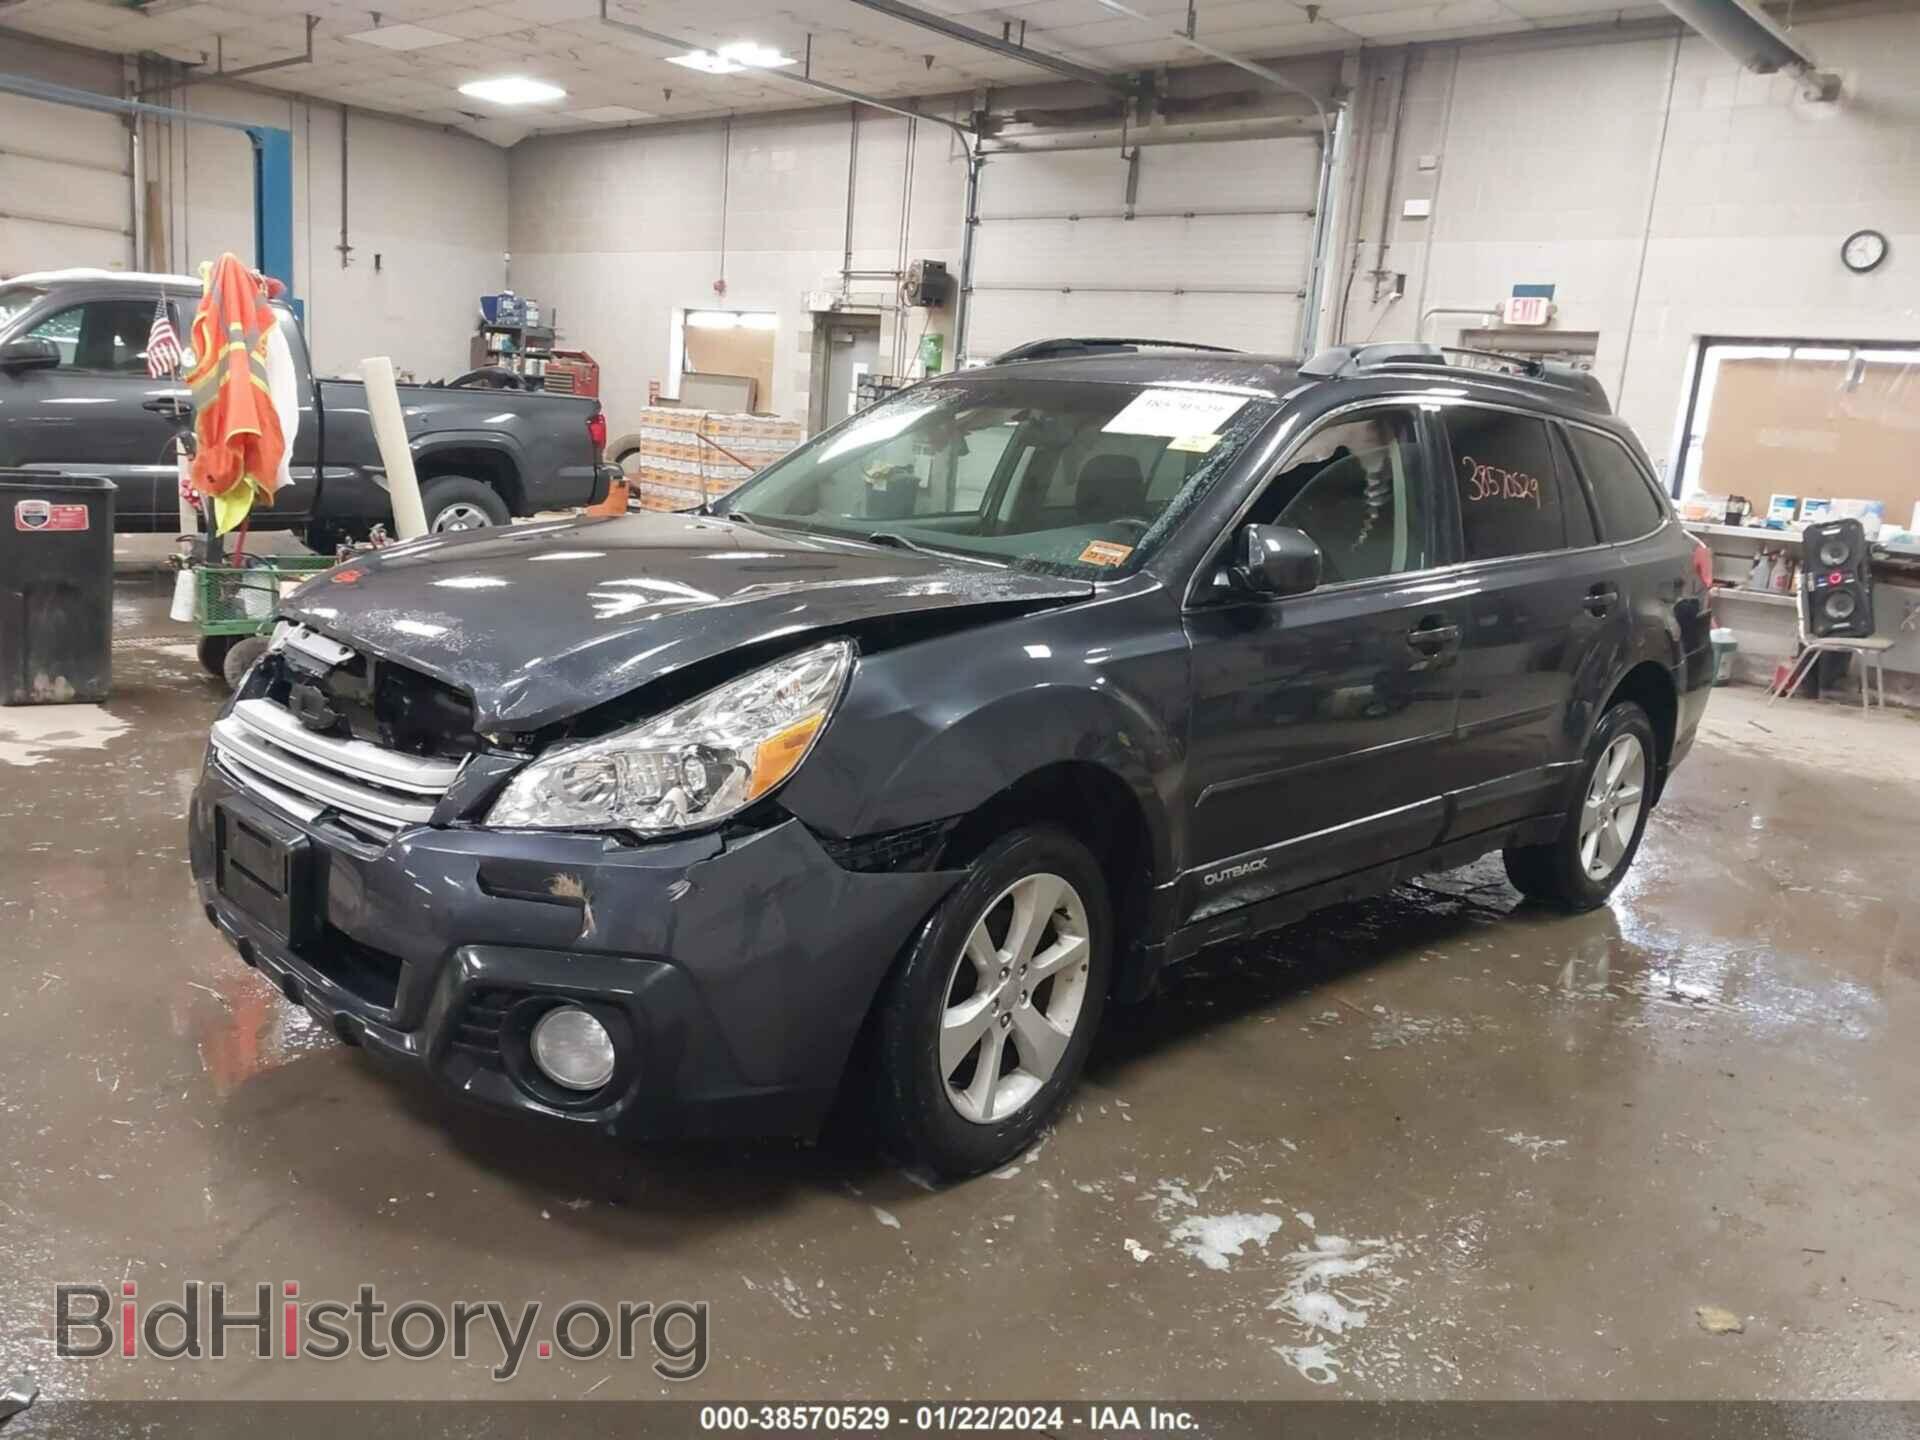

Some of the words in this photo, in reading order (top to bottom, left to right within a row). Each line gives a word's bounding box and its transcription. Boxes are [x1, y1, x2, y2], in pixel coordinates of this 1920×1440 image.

[1512, 299, 1542, 321] EXIT
[1462, 456, 1540, 509] 38570529
[1204, 857, 1268, 885] OUTBACK
